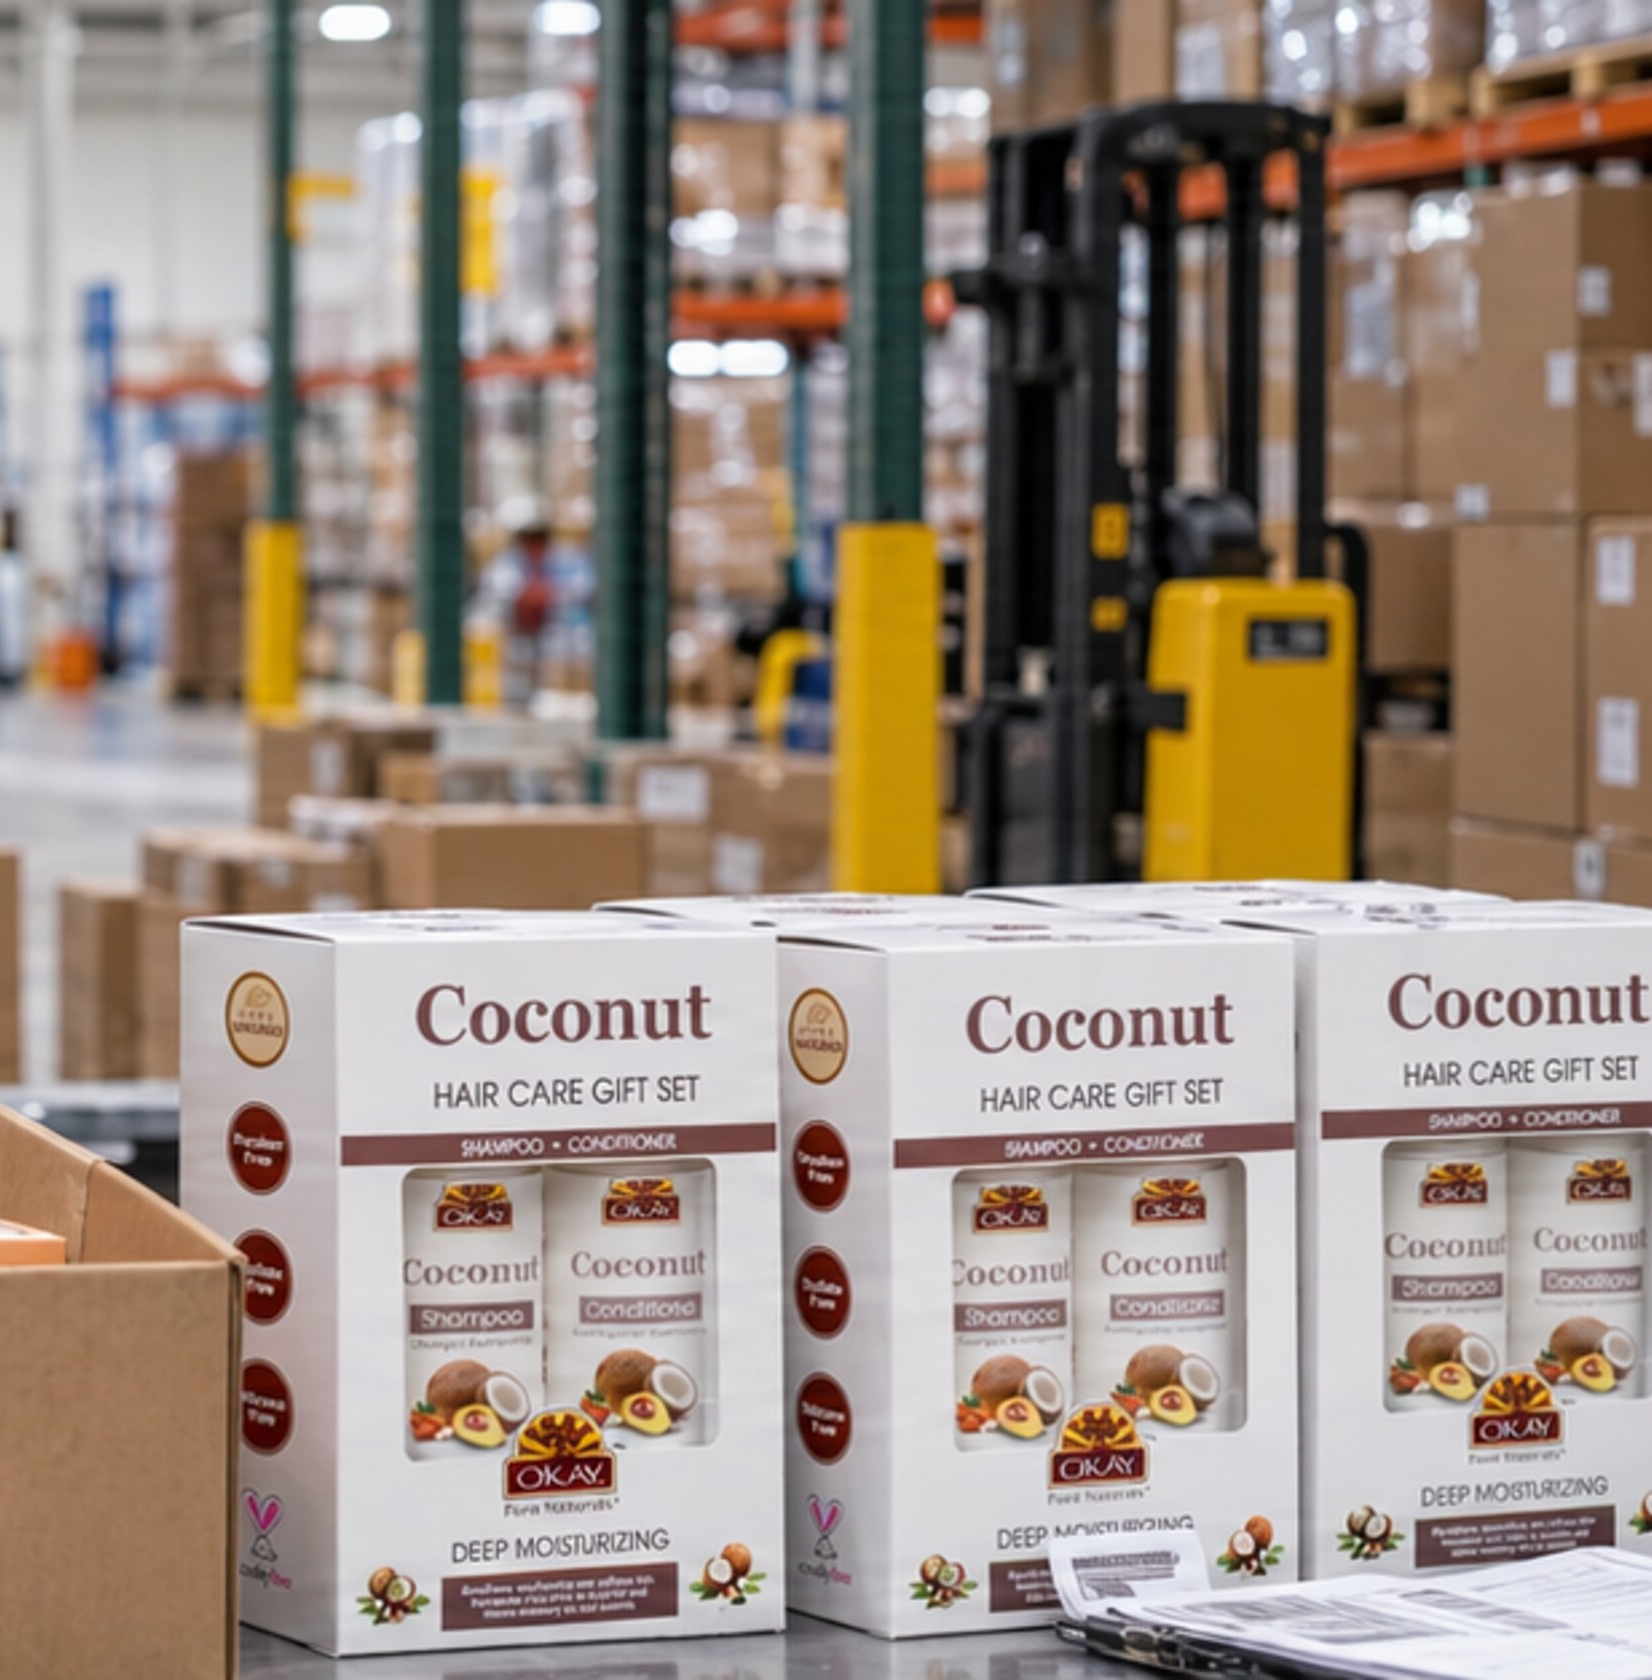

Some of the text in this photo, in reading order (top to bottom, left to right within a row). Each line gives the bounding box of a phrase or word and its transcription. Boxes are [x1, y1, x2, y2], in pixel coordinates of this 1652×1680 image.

[415, 983, 713, 1046] Coconut
[1388, 973, 1650, 1030] Coconut
[966, 994, 1235, 1054] Coconut
[1403, 1056, 1639, 1087] HAIR CARE GIFT SET
[433, 1075, 700, 1109] HAIR CARE GIFT SET
[980, 1078, 1223, 1113] HAIR CARE GIFT SET
[403, 1254, 539, 1287] Coconut
[571, 1249, 706, 1279] Coconut
[1101, 1247, 1228, 1277] Coconut
[421, 1308, 524, 1331] Shampoo
[1480, 1417, 1552, 1441] OKAY
[516, 1461, 604, 1489] OKAY
[1059, 1455, 1135, 1480] OKAY
[1421, 1484, 1470, 1508] DEEP
[451, 1528, 670, 1563] DEEP MOISTURIZING
[997, 1525, 1048, 1549] DEEP
